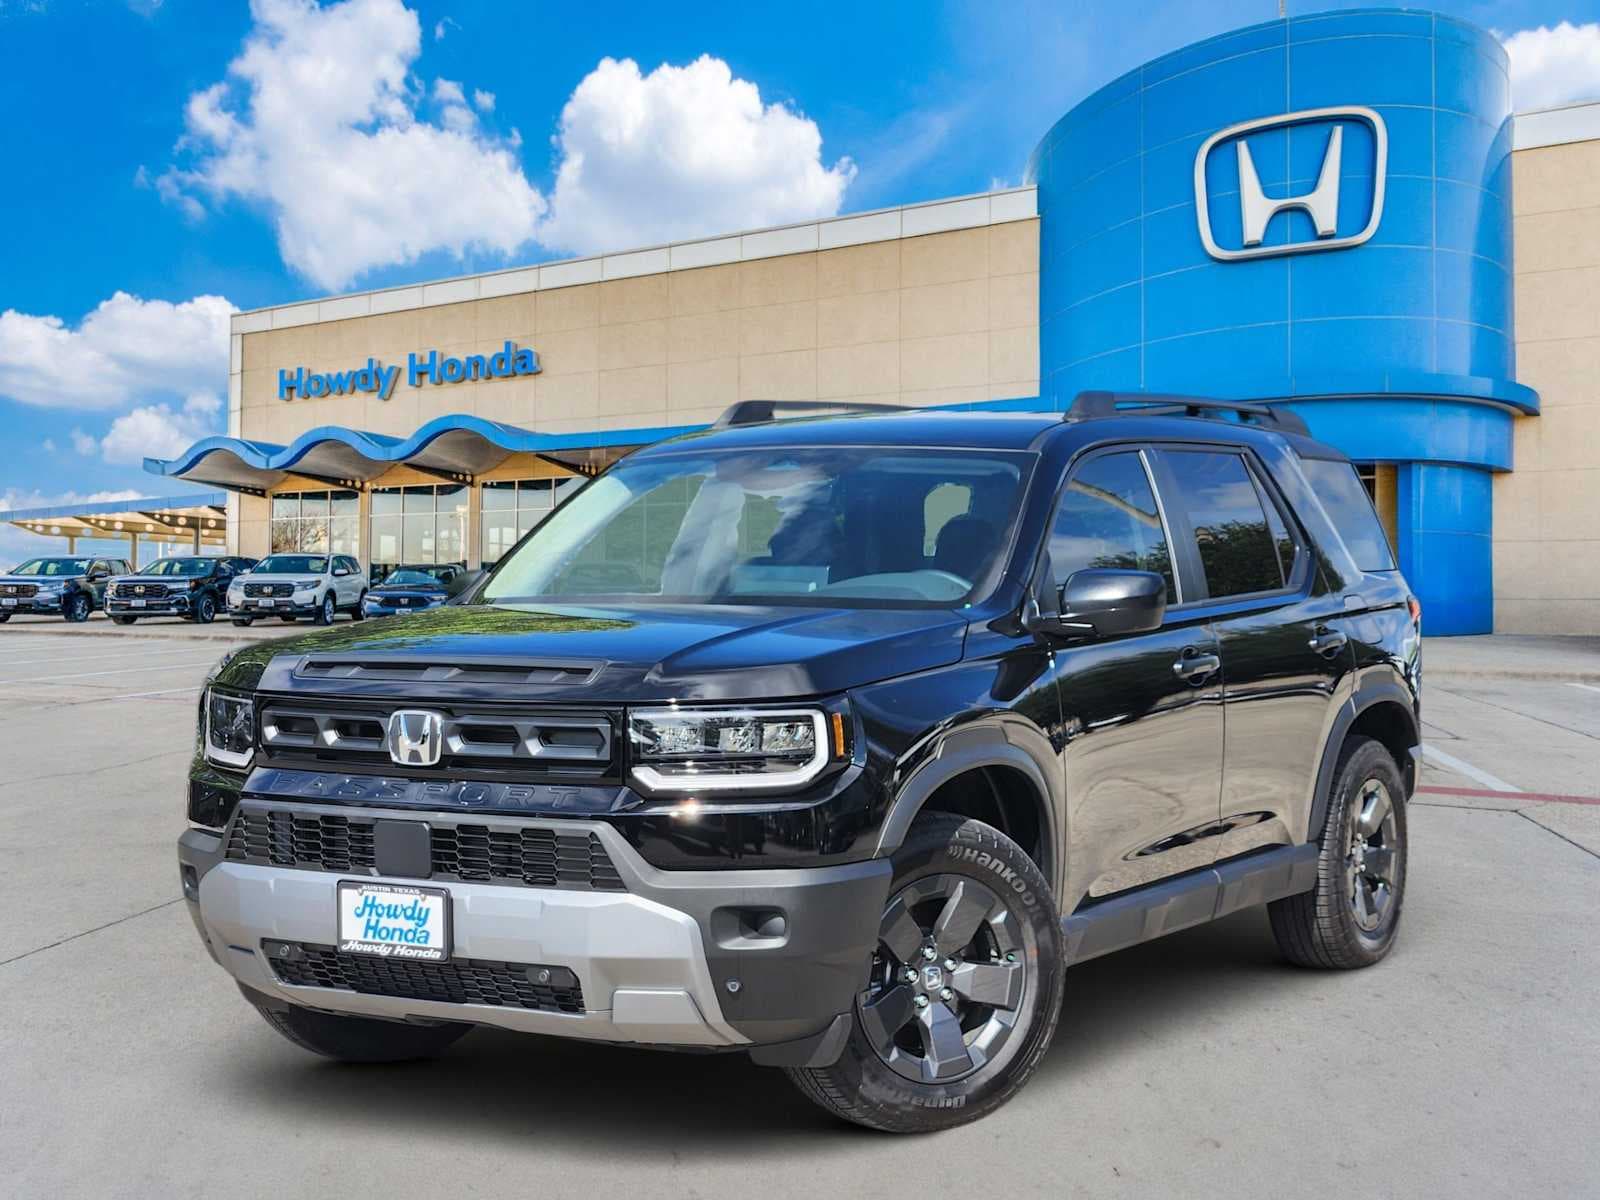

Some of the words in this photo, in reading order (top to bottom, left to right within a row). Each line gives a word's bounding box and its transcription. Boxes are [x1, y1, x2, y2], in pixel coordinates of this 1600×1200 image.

[278, 358, 401, 400] Howdy
[408, 340, 542, 387] Honda
[269, 772, 583, 808] PASSPORT
[362, 885, 391, 893] AUSTIN
[393, 887, 420, 895] TEXAS
[355, 895, 430, 927] Howdy
[364, 918, 429, 944] Honda
[342, 941, 392, 955] Howdy
[394, 946, 441, 959] Honda
